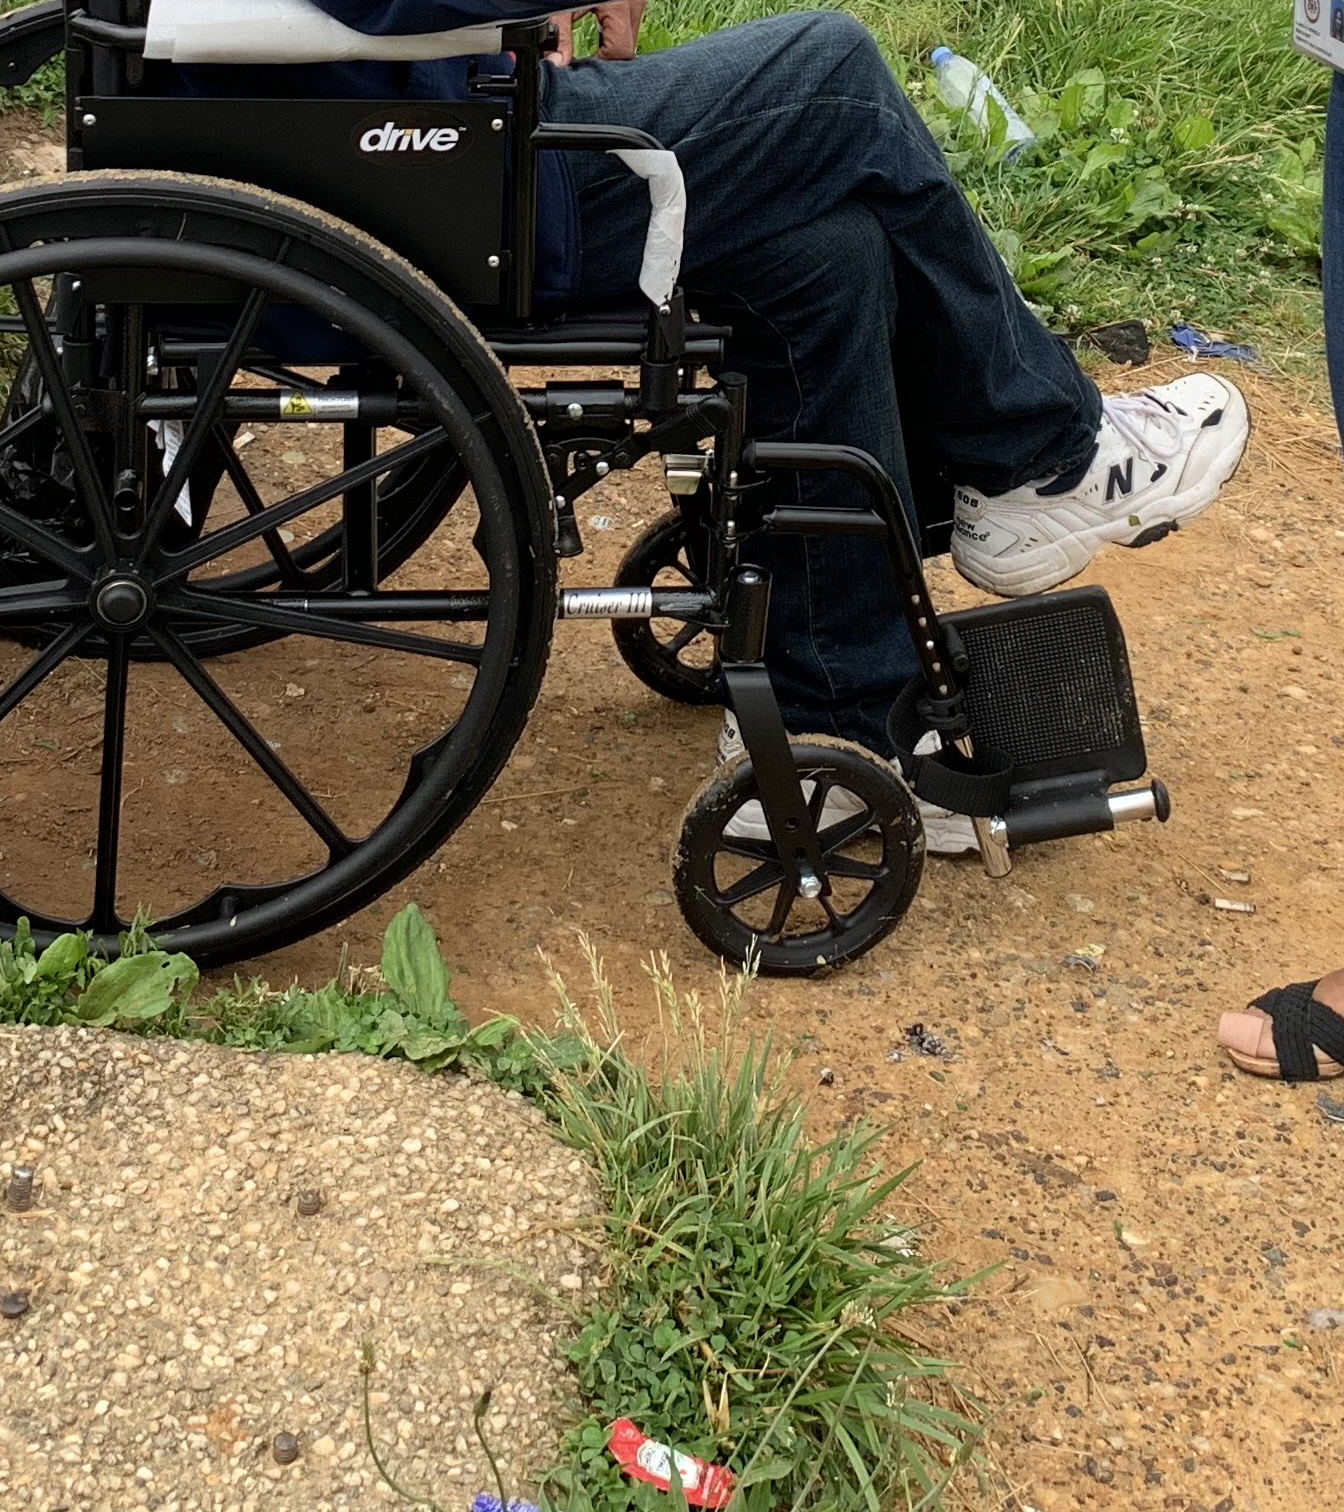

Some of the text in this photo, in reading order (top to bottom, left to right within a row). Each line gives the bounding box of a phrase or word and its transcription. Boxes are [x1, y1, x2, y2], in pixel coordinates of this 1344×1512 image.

[359, 121, 459, 152] drive
[1105, 456, 1134, 503] N
[567, 592, 649, 615] Cruiser III
